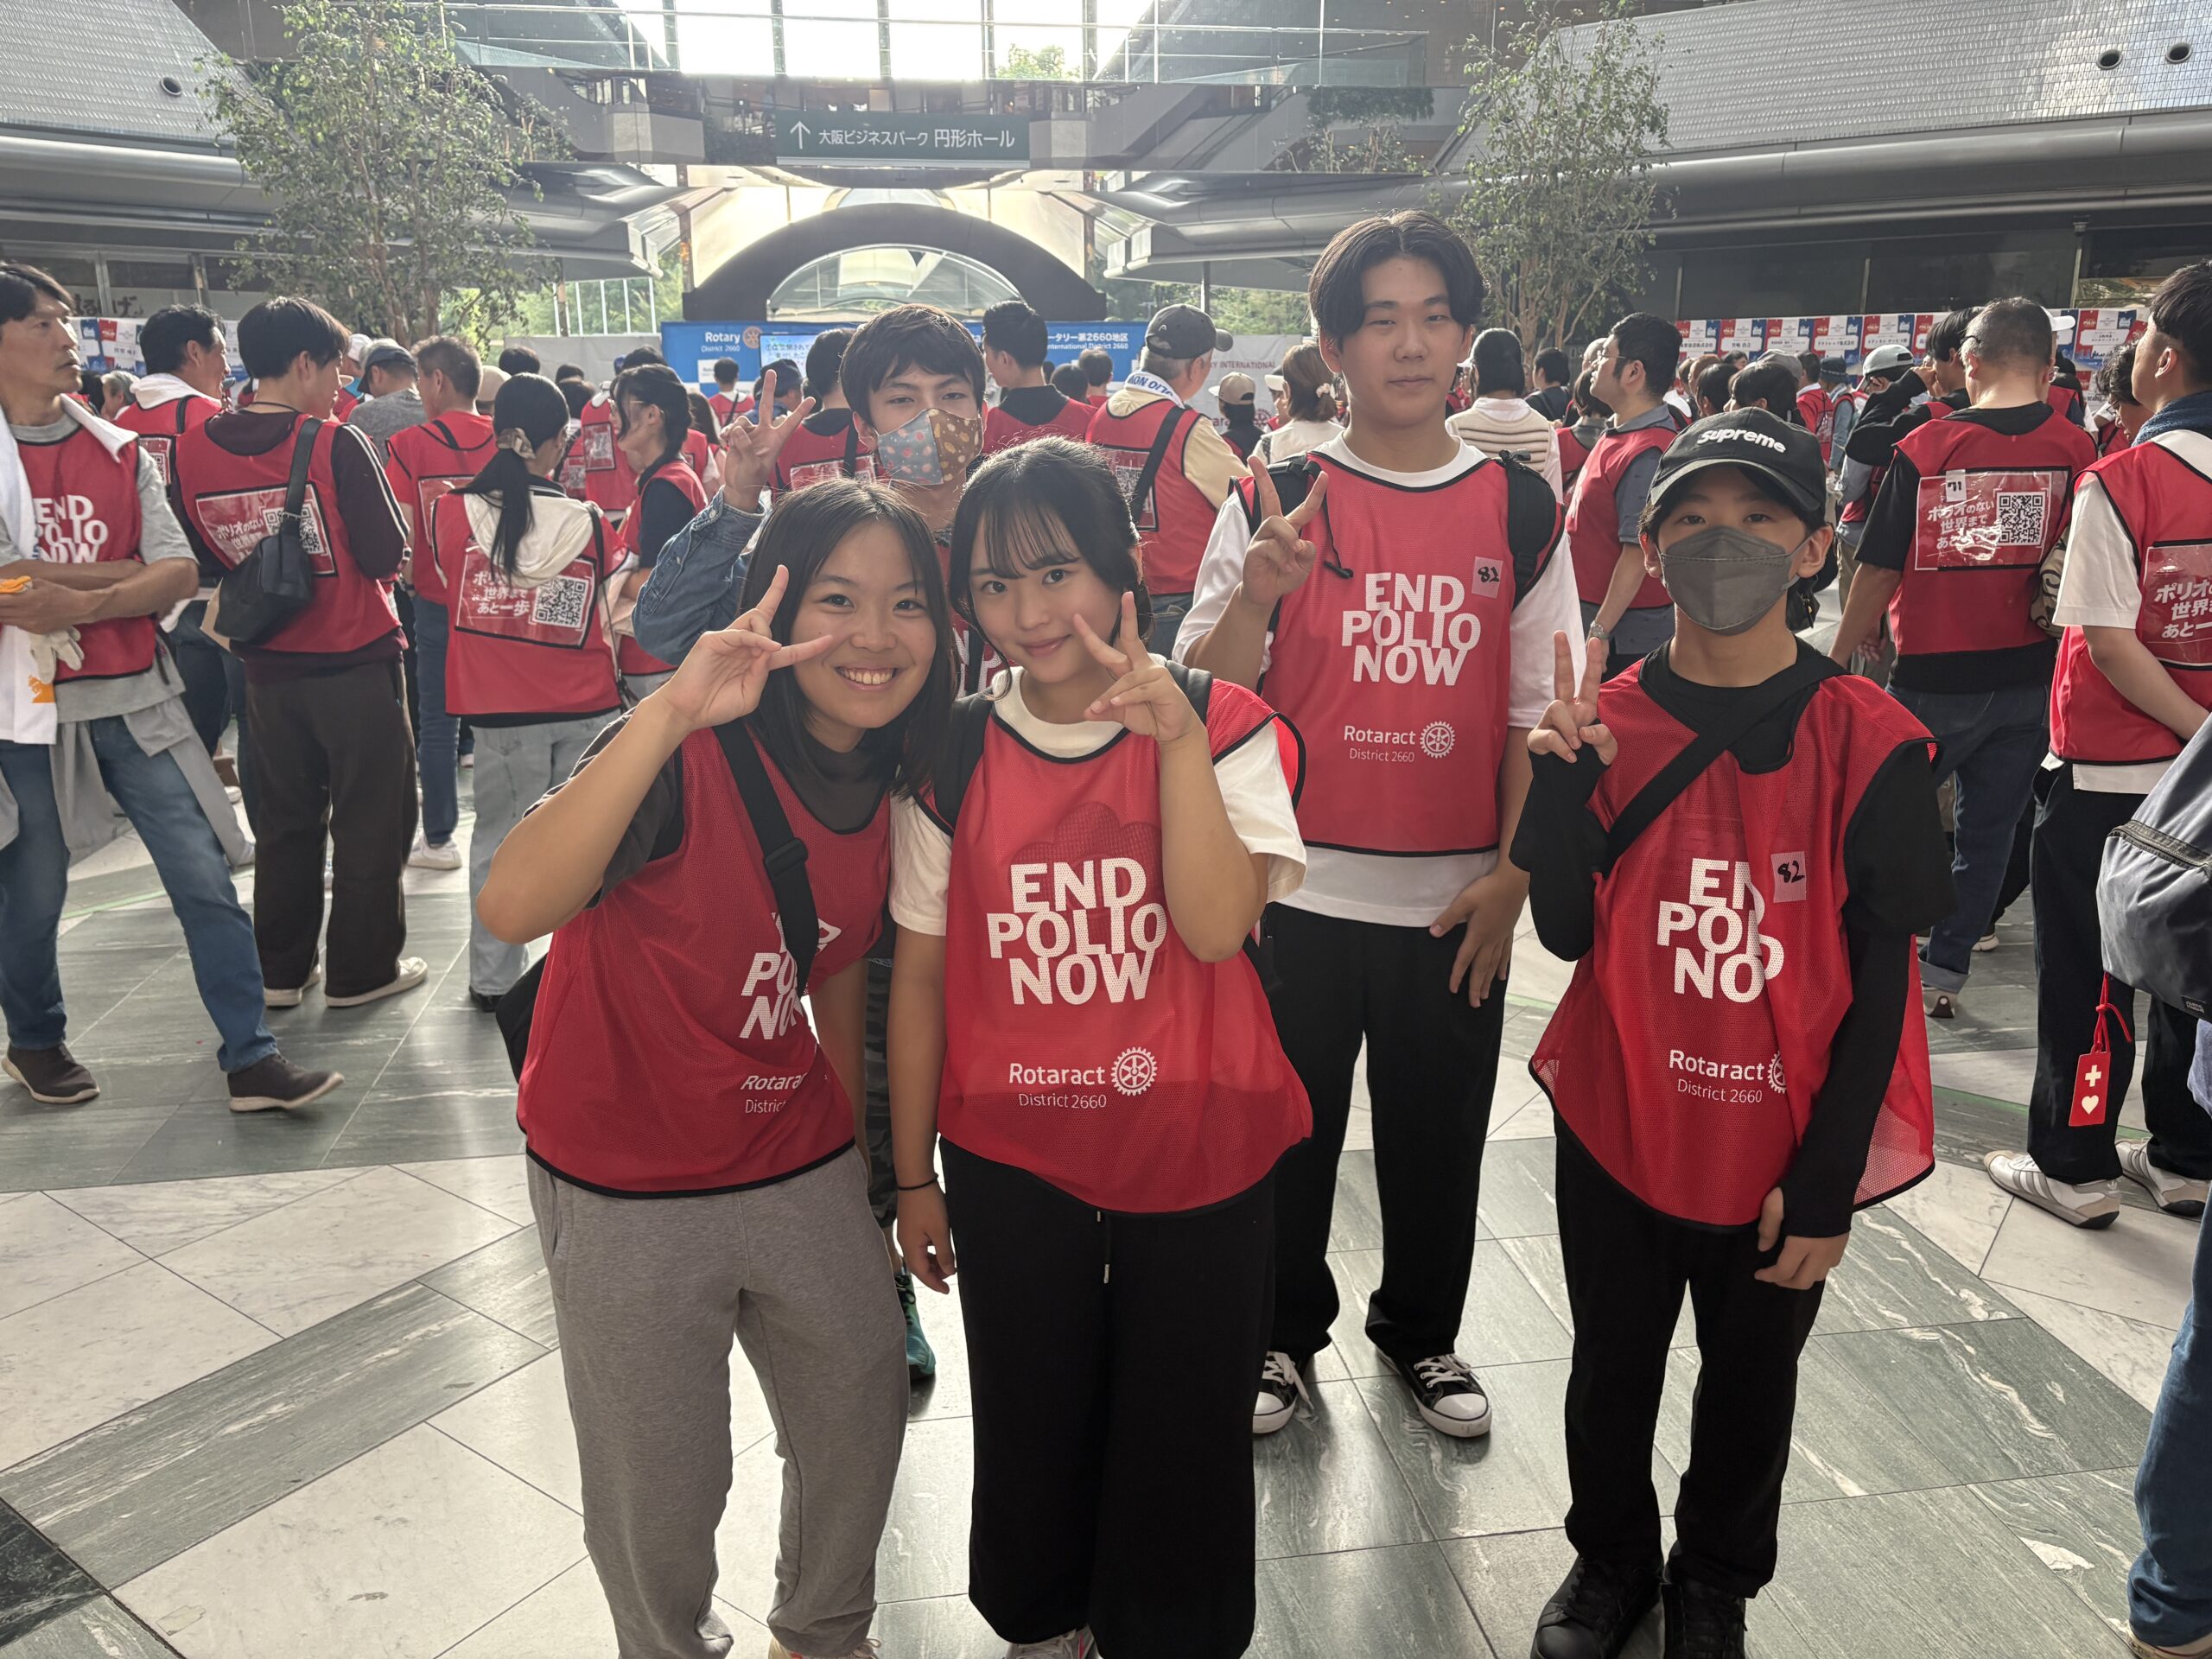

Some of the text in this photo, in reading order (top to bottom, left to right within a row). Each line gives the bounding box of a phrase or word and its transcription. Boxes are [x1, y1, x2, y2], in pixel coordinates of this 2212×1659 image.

[818, 129, 1015, 148] 大阪ビジネスパーク 円形ホール
[705, 332, 741, 344] Rotary
[1697, 429, 1786, 454] Supreme
[33, 494, 94, 524] END
[1940, 514, 1987, 535] 世界まで
[1365, 572, 1465, 613] END
[477, 601, 531, 617] あと一歩
[1341, 608, 1482, 651] POLIO
[1353, 645, 1468, 686] NOW
[1344, 725, 1416, 745] Rotaract
[1350, 748, 1415, 762] District 2660
[1010, 857, 1147, 913] END
[987, 903, 1167, 959] POLIO
[1009, 952, 1155, 1005] NOW
[1674, 947, 1765, 1003] NO
[1009, 1063, 1106, 1085] Rotaract
[1669, 1049, 1764, 1081] Rotaract
[741, 1072, 809, 1090] Rotara
[1678, 1078, 1763, 1103] District 2660
[1019, 1093, 1107, 1109] District 2660
